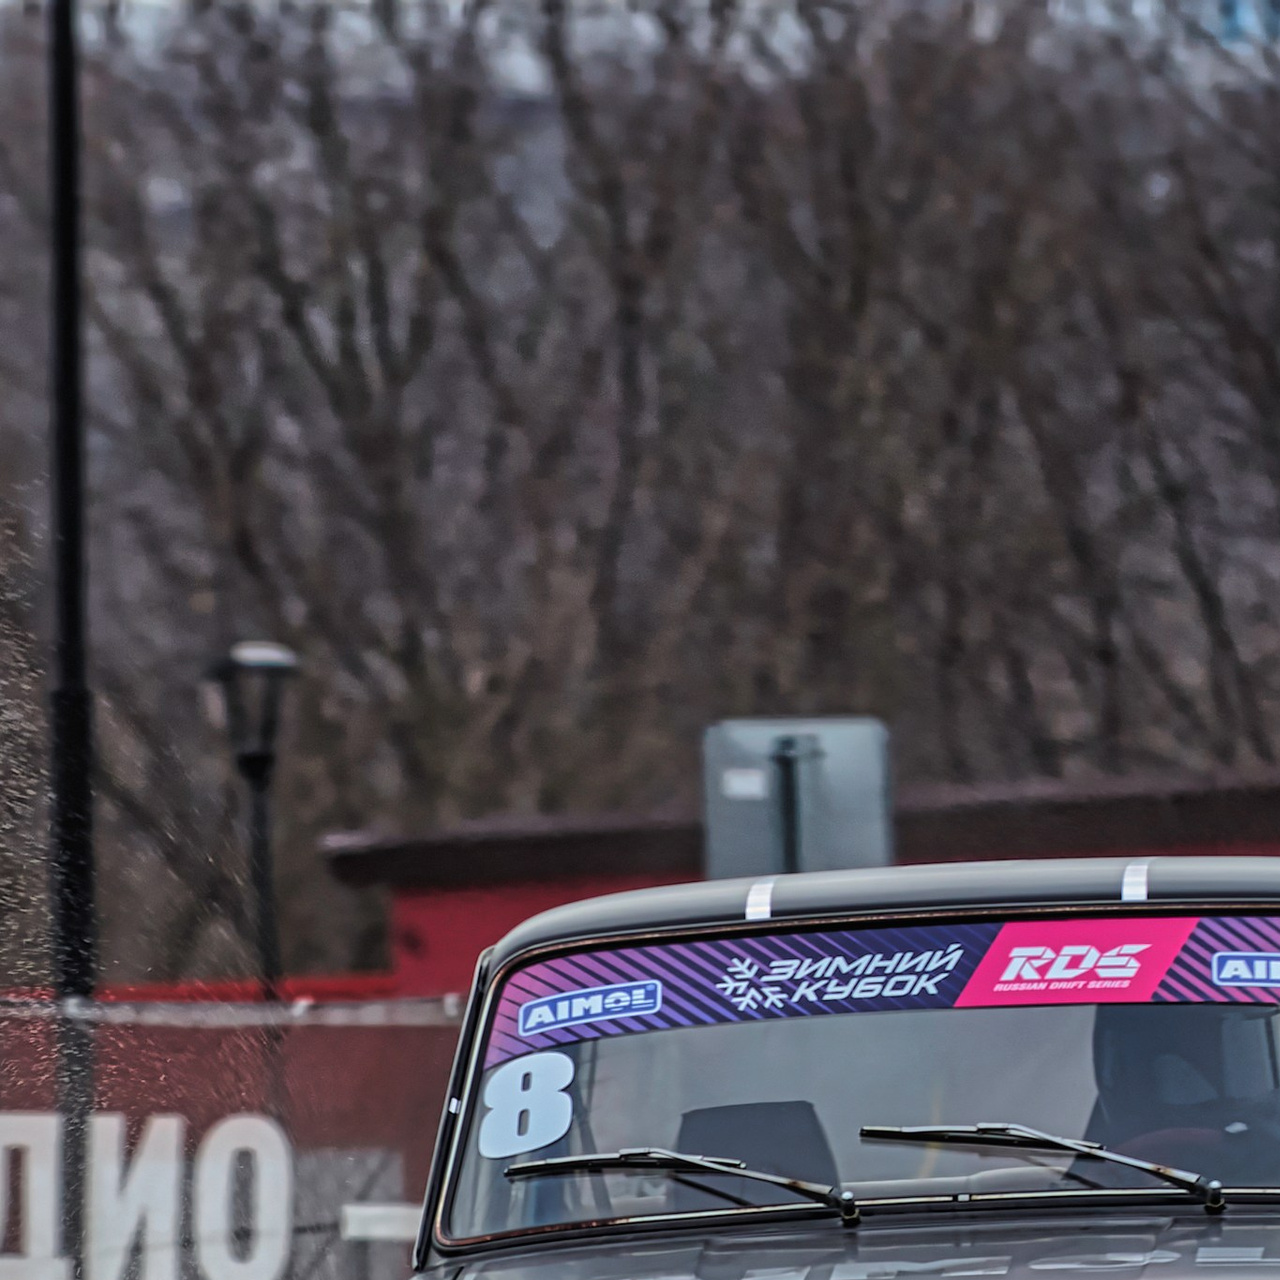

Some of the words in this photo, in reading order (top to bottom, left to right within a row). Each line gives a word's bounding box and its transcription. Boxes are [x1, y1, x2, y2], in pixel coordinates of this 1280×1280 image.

[761, 943, 964, 982] ЗИМНИЙ
[999, 943, 1152, 981] RDS
[791, 972, 950, 1003] КУБОК
[993, 982, 1048, 992] RUSSIAN
[1048, 981, 1088, 990] DRIFT
[1087, 980, 1131, 989] SERIES
[524, 988, 654, 1030] AIMOL
[478, 1052, 574, 1159] 8
